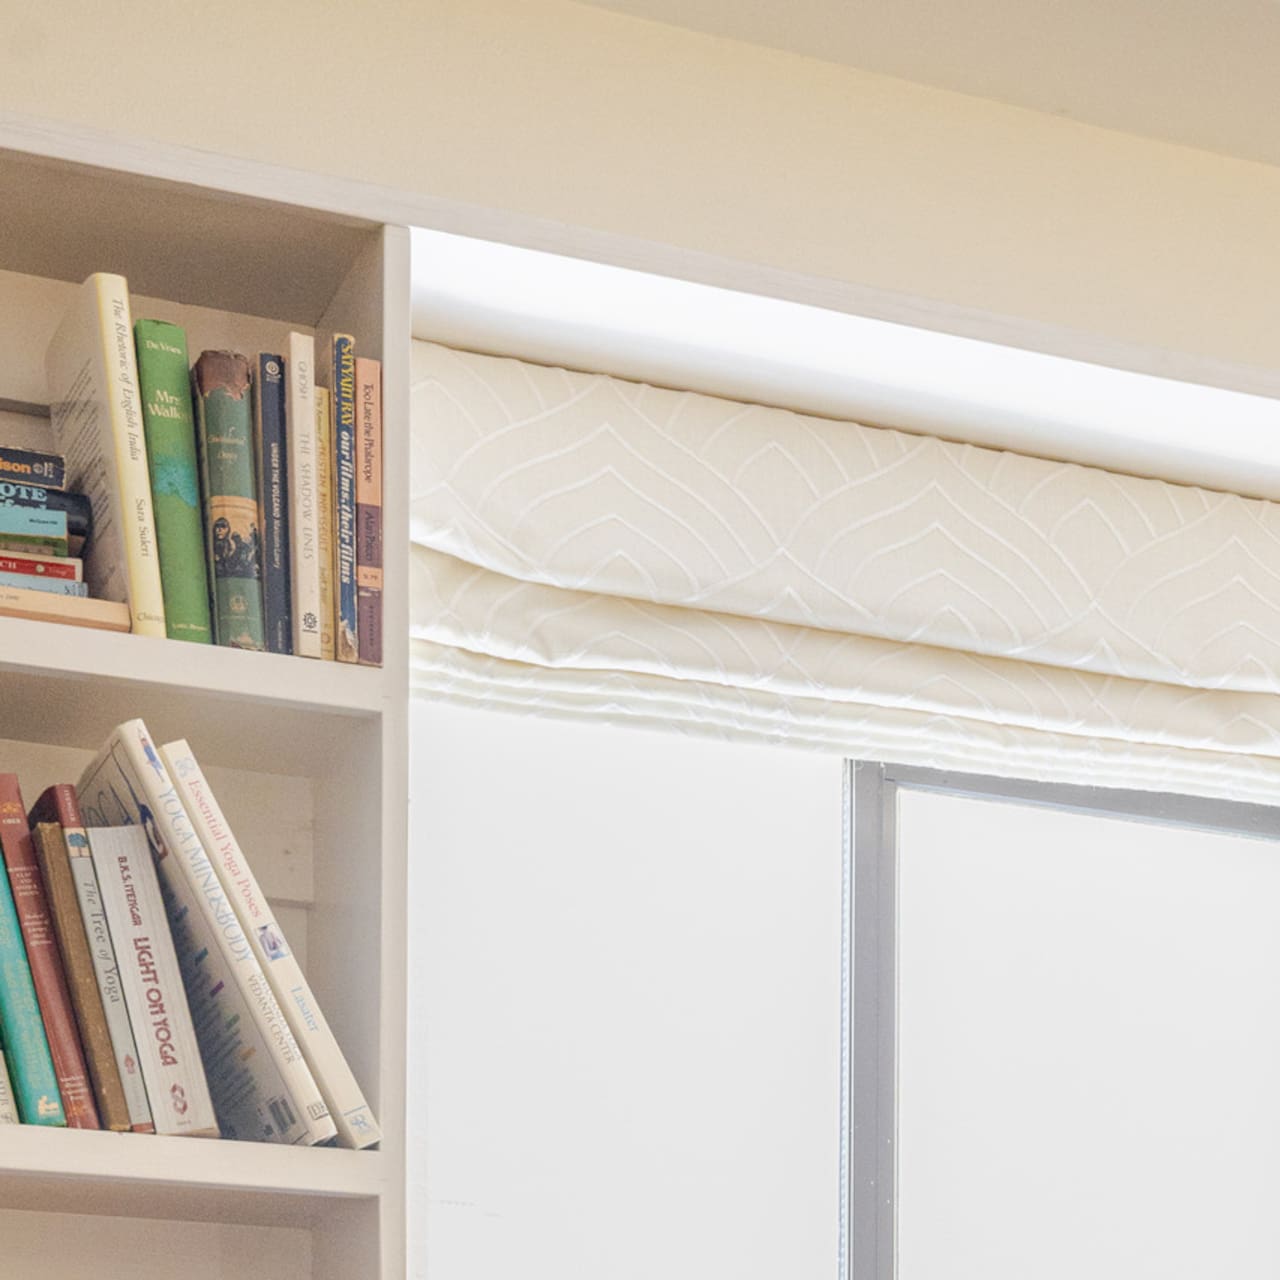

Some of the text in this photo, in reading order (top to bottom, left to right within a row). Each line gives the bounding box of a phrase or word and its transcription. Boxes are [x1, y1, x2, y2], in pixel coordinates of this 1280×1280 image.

[112, 298, 141, 462] The Rhetoric of English India
[341, 401, 354, 426] RAY
[341, 430, 352, 456] our
[362, 383, 376, 484] Too Late the Phalarope
[270, 443, 281, 519] UNDER THE VOLCANO
[300, 433, 315, 561] THE SHADOW LINES
[135, 498, 151, 558] Sara Suleri
[341, 542, 354, 584] films
[158, 786, 194, 848] YOGA
[188, 779, 264, 919] Essential Yoga Poses
[83, 880, 122, 1003] The Tree of Yoga
[133, 937, 179, 1067] LIGHT ON YOGA
[290, 986, 320, 1032] Lasater
